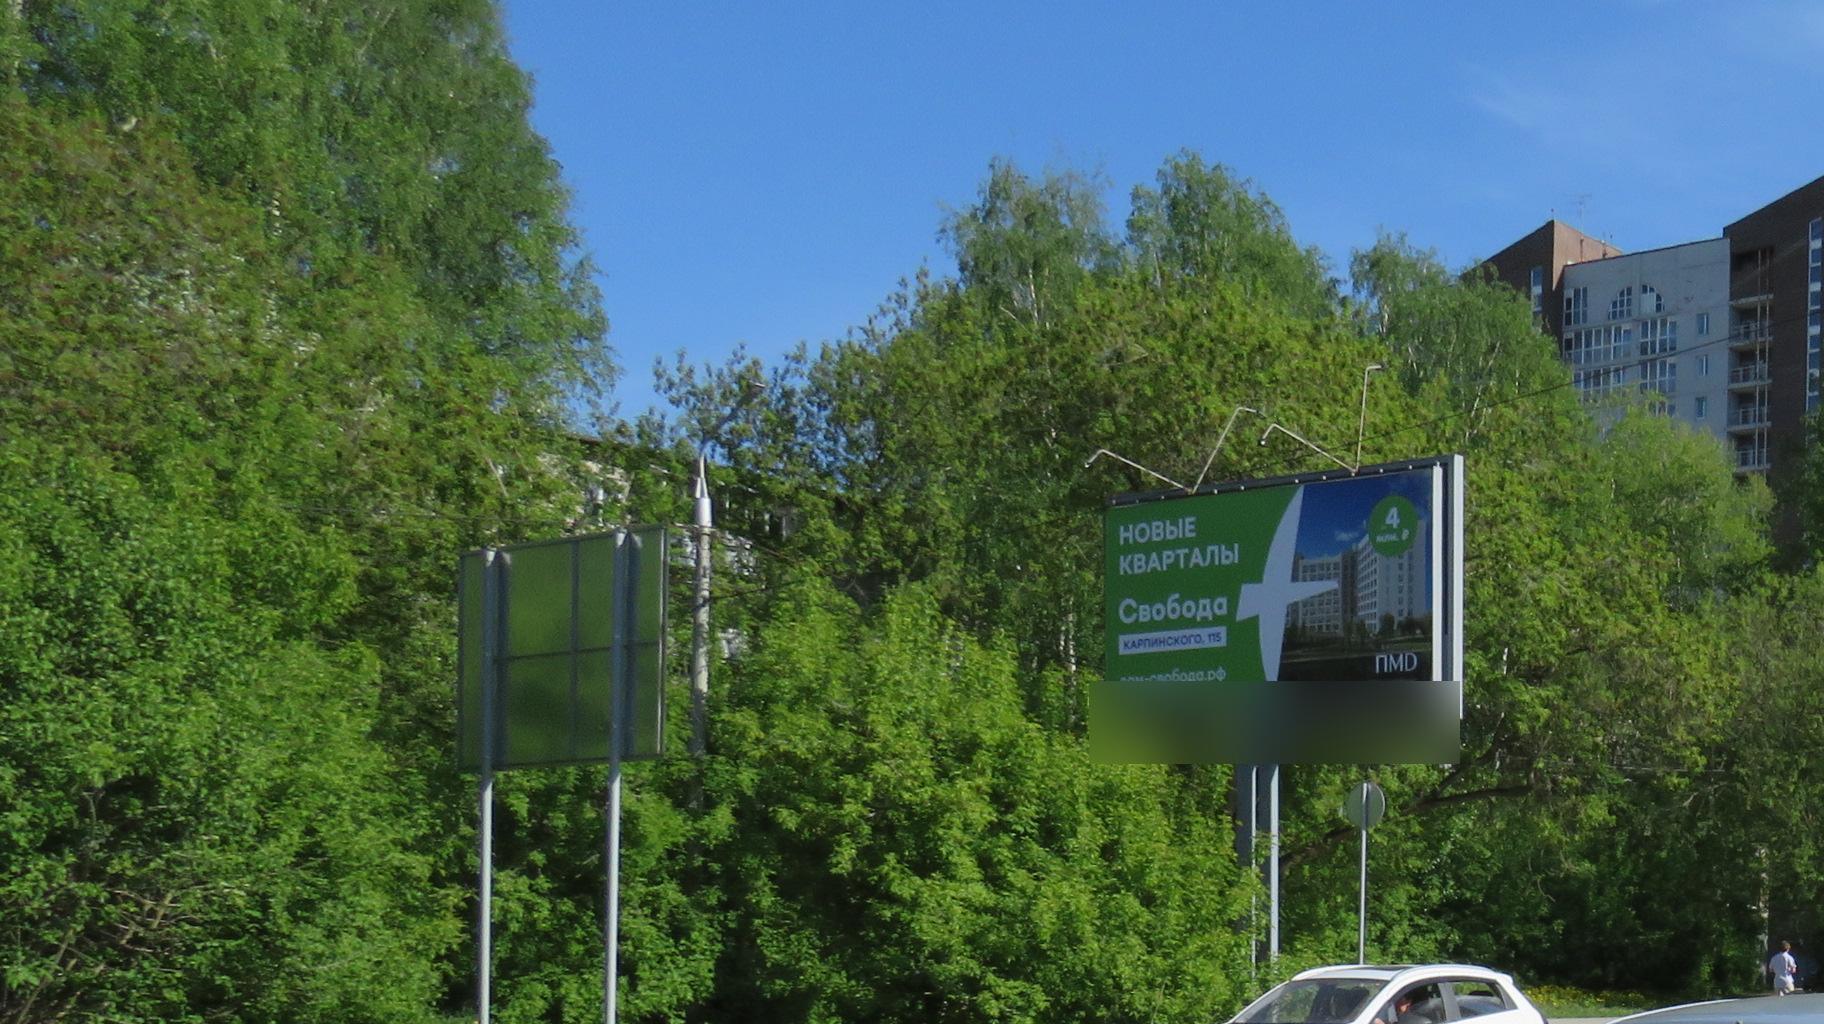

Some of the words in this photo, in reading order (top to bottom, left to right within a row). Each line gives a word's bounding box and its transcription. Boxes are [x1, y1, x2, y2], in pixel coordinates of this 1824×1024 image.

[1120, 517, 1197, 545] НОВЫЕ
[1385, 507, 1400, 528] 4
[1120, 543, 1239, 575] КВАРТАЛЫ
[1119, 593, 1228, 624] Свобода
[1208, 632, 1222, 643] 115
